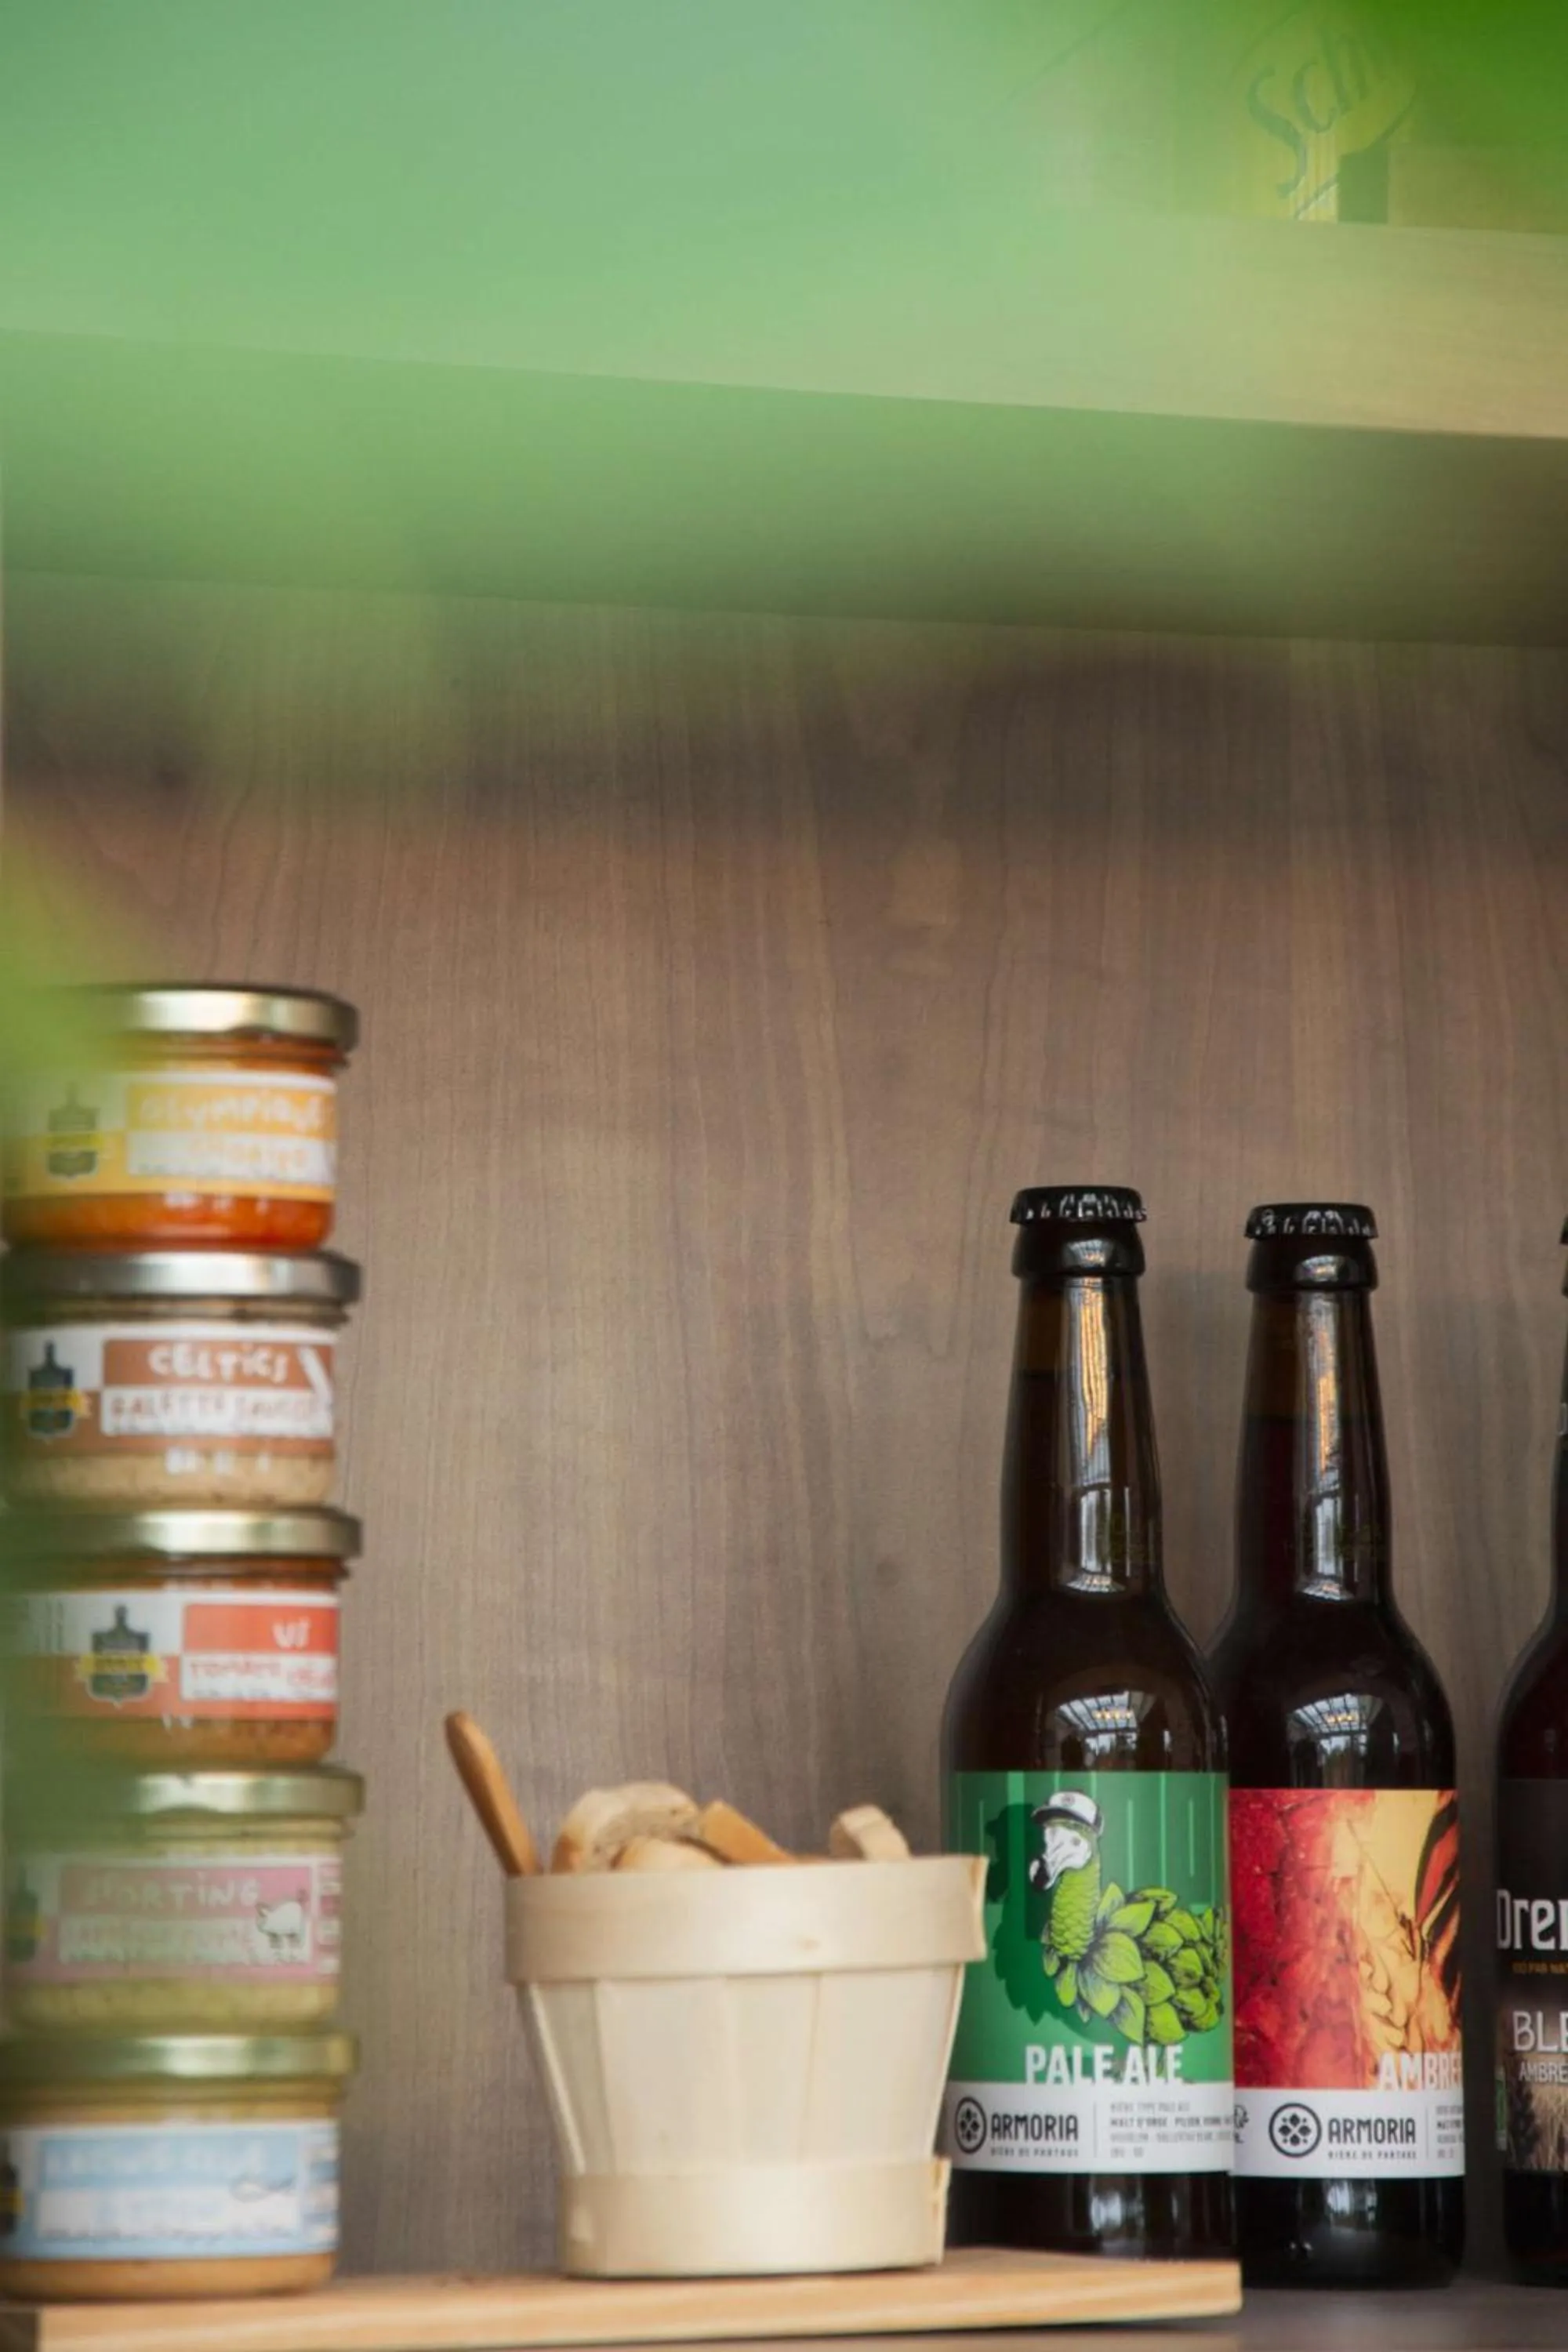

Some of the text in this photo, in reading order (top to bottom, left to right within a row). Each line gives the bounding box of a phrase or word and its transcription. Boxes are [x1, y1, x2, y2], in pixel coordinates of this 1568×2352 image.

[1496, 1889, 1568, 1951] Dre
[1025, 2044, 1184, 2085] PALE ALE
[991, 2113, 1079, 2141] ARMORIA
[1328, 2118, 1416, 2144] ARMORIA
